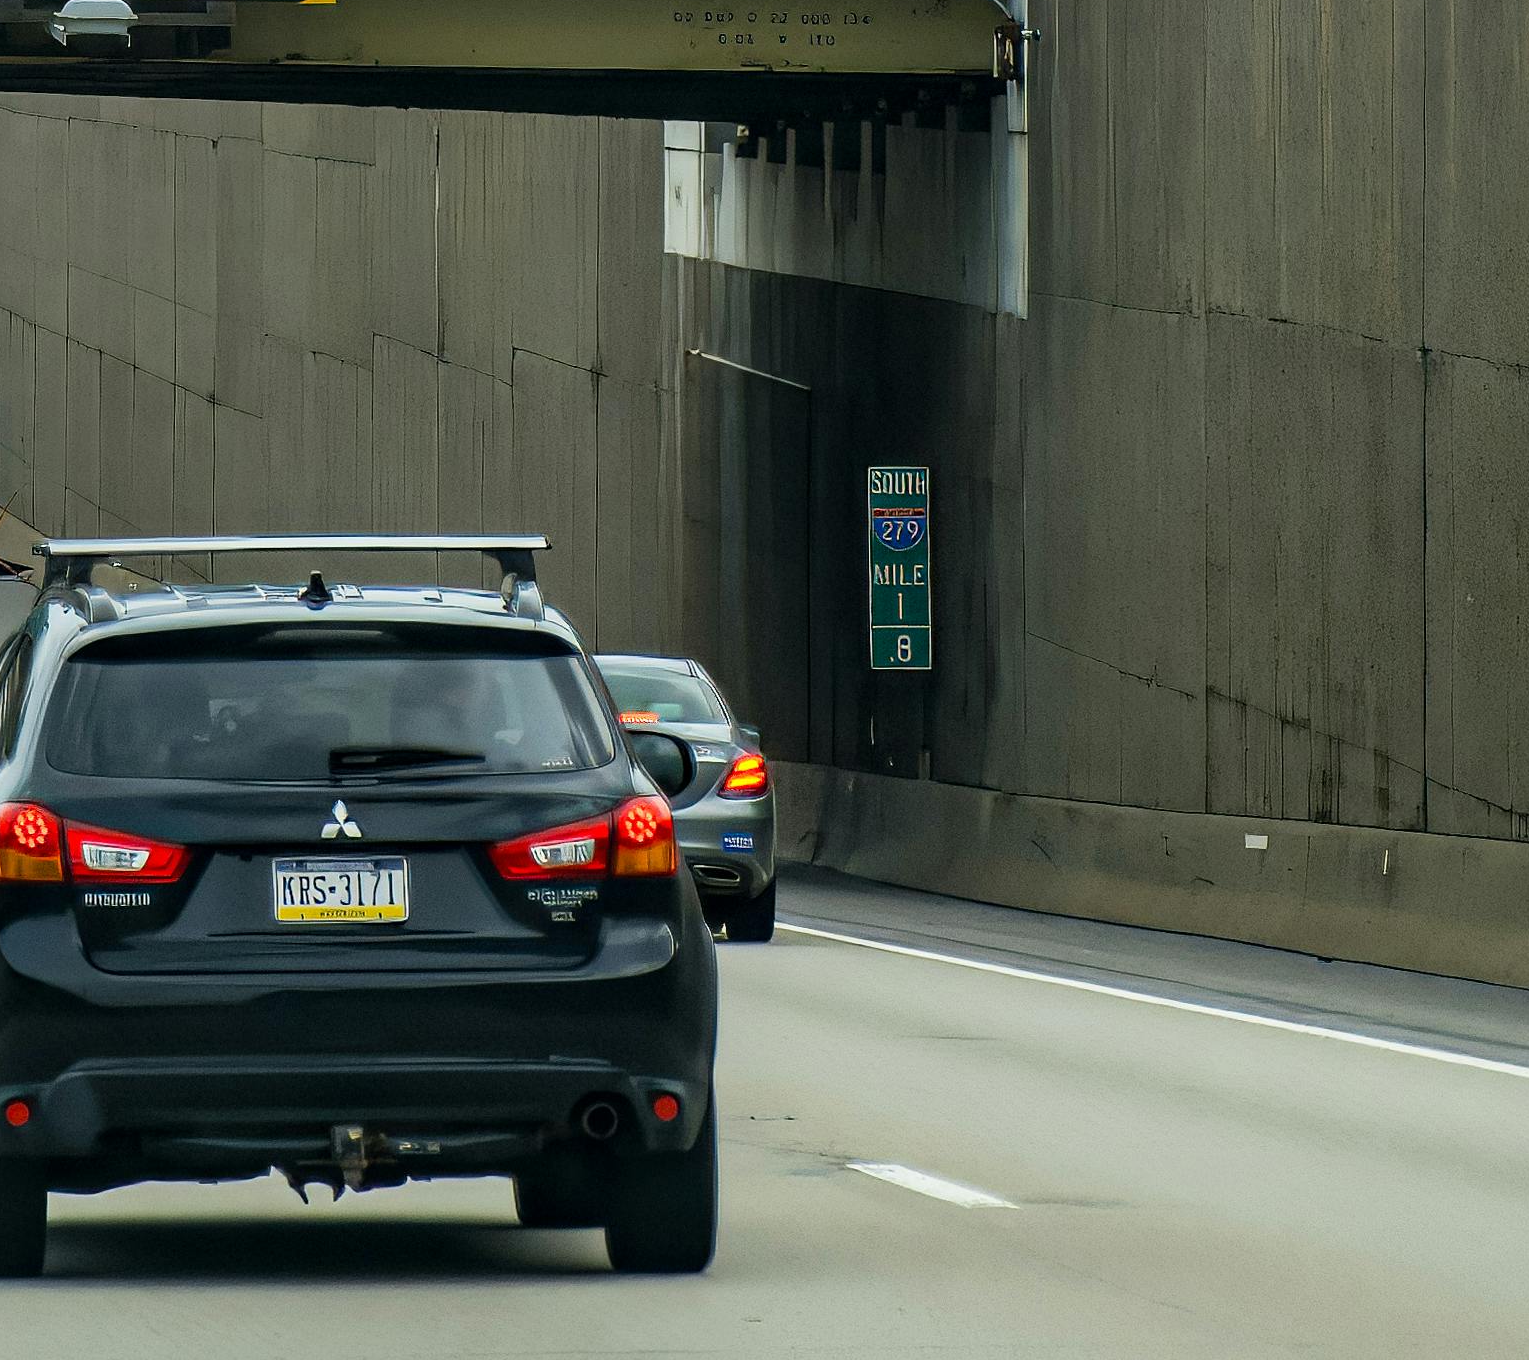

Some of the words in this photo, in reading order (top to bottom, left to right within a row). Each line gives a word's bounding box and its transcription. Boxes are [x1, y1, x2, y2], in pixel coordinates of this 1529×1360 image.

[871, 471, 925, 495] SOUTH
[881, 521, 919, 541] 279
[874, 564, 925, 586] MILE
[897, 593, 903, 620] 1
[282, 872, 395, 906] KRS-3171
